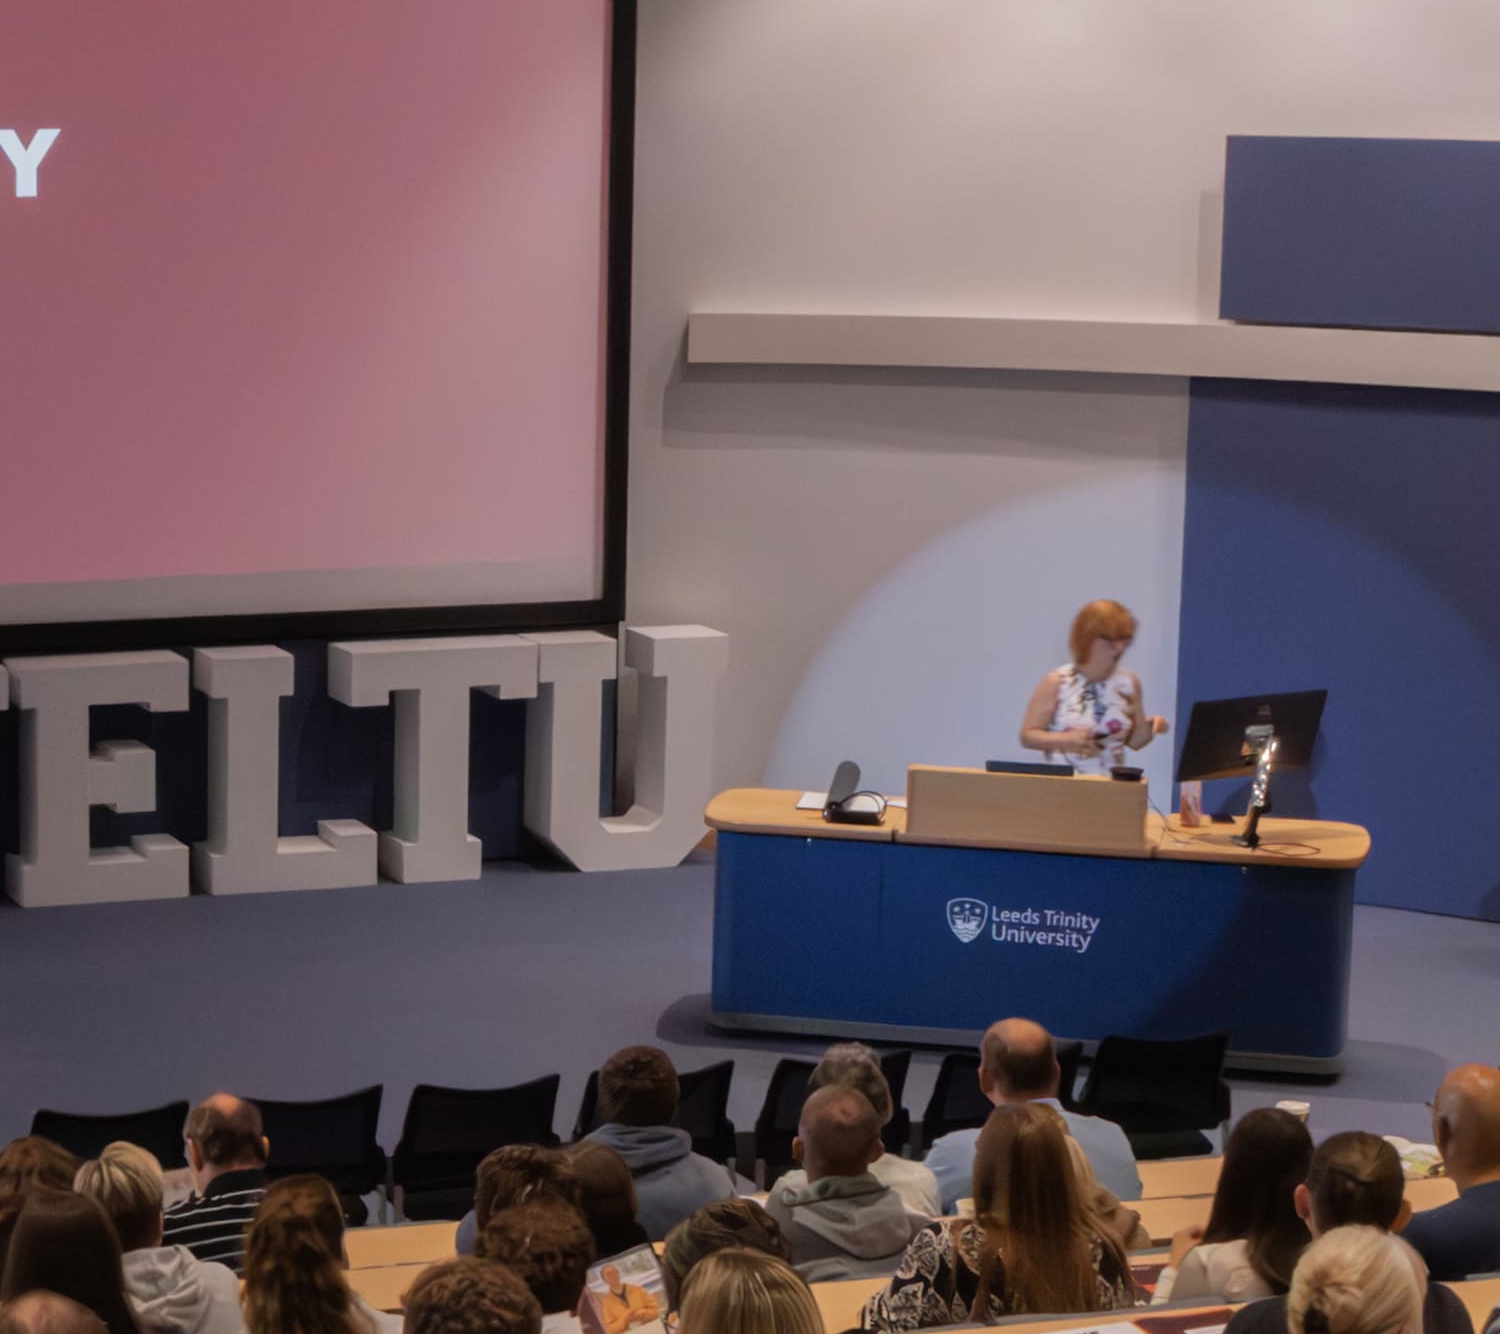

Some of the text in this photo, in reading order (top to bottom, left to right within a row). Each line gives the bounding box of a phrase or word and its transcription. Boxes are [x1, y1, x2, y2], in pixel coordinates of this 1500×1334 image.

[991, 905, 1101, 934] Leeds Trinity
[991, 923, 1092, 953] University
